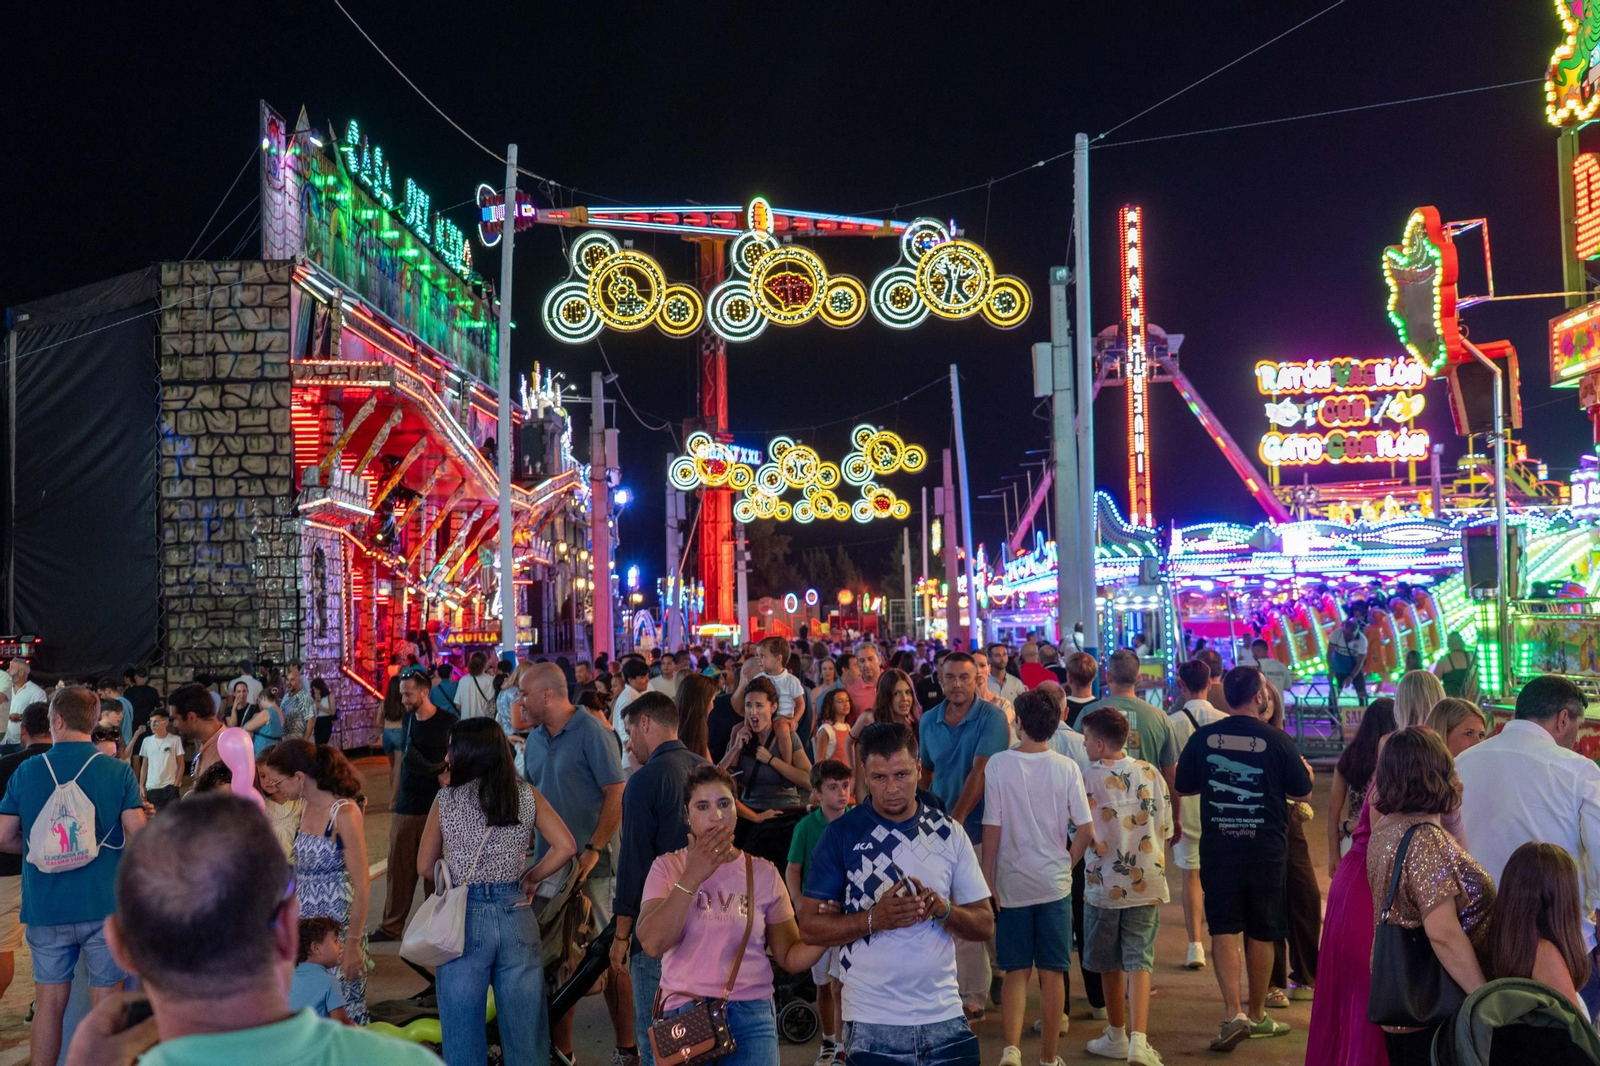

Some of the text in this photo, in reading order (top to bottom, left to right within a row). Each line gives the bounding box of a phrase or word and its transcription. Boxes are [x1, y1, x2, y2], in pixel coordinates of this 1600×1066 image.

[1322, 399, 1366, 423] CON
[1263, 434, 1323, 462] GATO
[444, 632, 498, 644] AQUILLA
